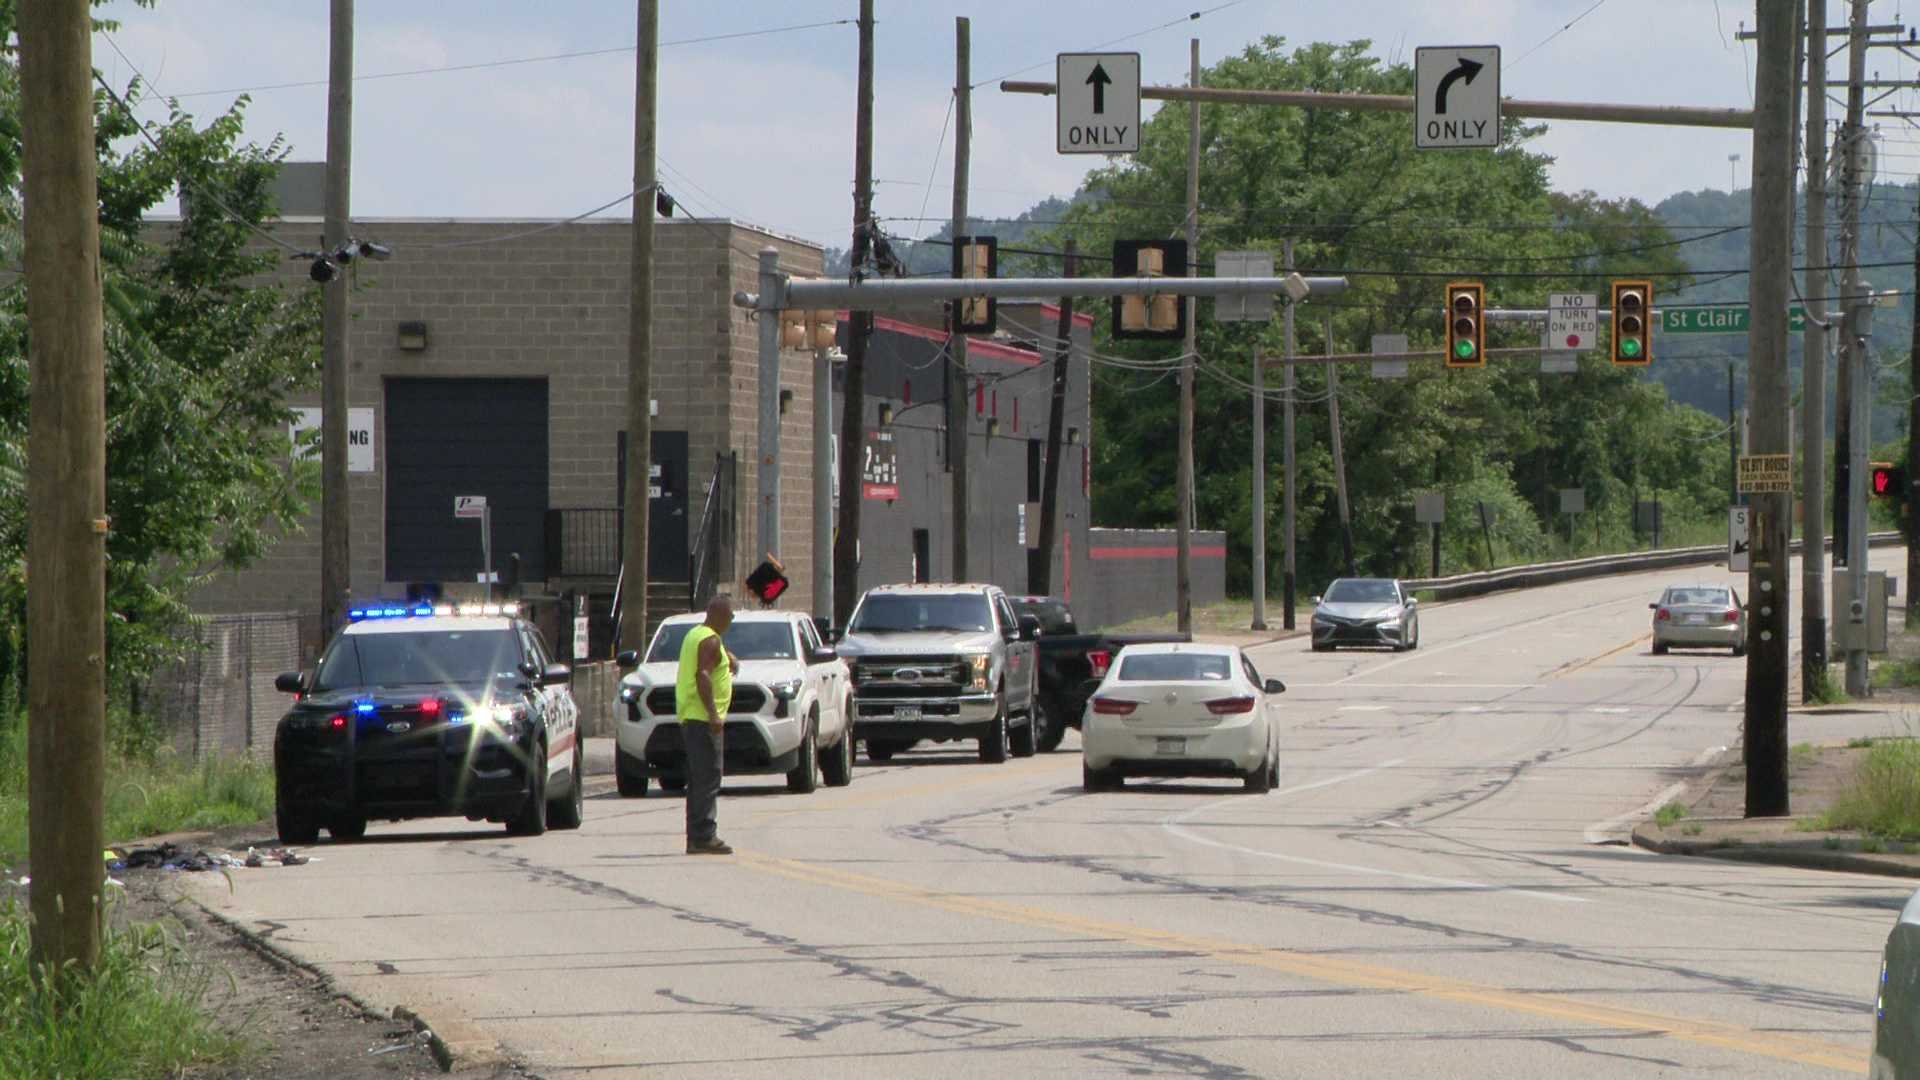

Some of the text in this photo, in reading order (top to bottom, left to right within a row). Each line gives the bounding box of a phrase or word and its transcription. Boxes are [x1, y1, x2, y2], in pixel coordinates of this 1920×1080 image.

[1069, 126, 1128, 145] ONLY
[1427, 120, 1487, 139] ONLY
[1562, 295, 1583, 306] NO
[1560, 310, 1588, 320] TURN
[1669, 310, 1743, 327] St Clair
[1551, 322, 1594, 331] ON RED
